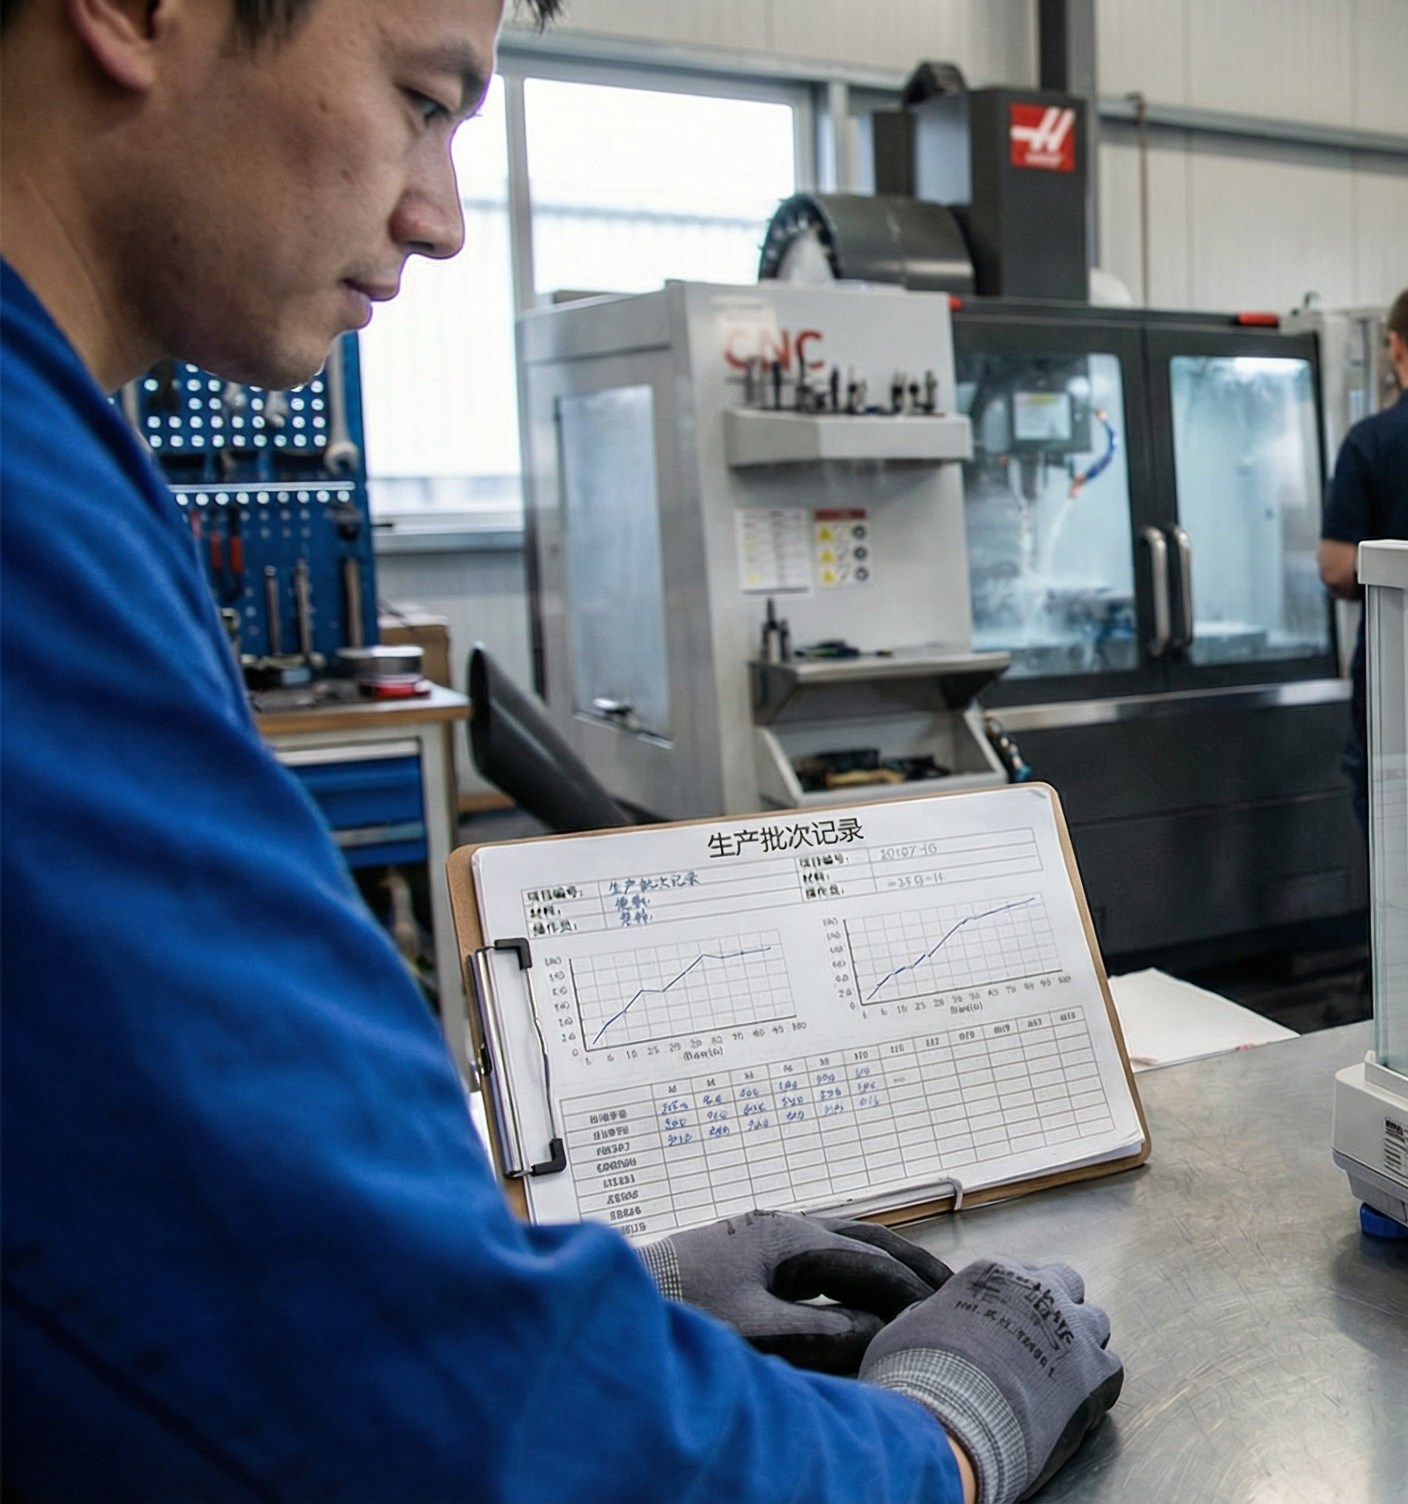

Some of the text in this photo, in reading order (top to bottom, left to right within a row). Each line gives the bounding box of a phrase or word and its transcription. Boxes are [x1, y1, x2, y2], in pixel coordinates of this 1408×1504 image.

[723, 329, 825, 372] CNC
[707, 817, 865, 859] 生产批次记录
